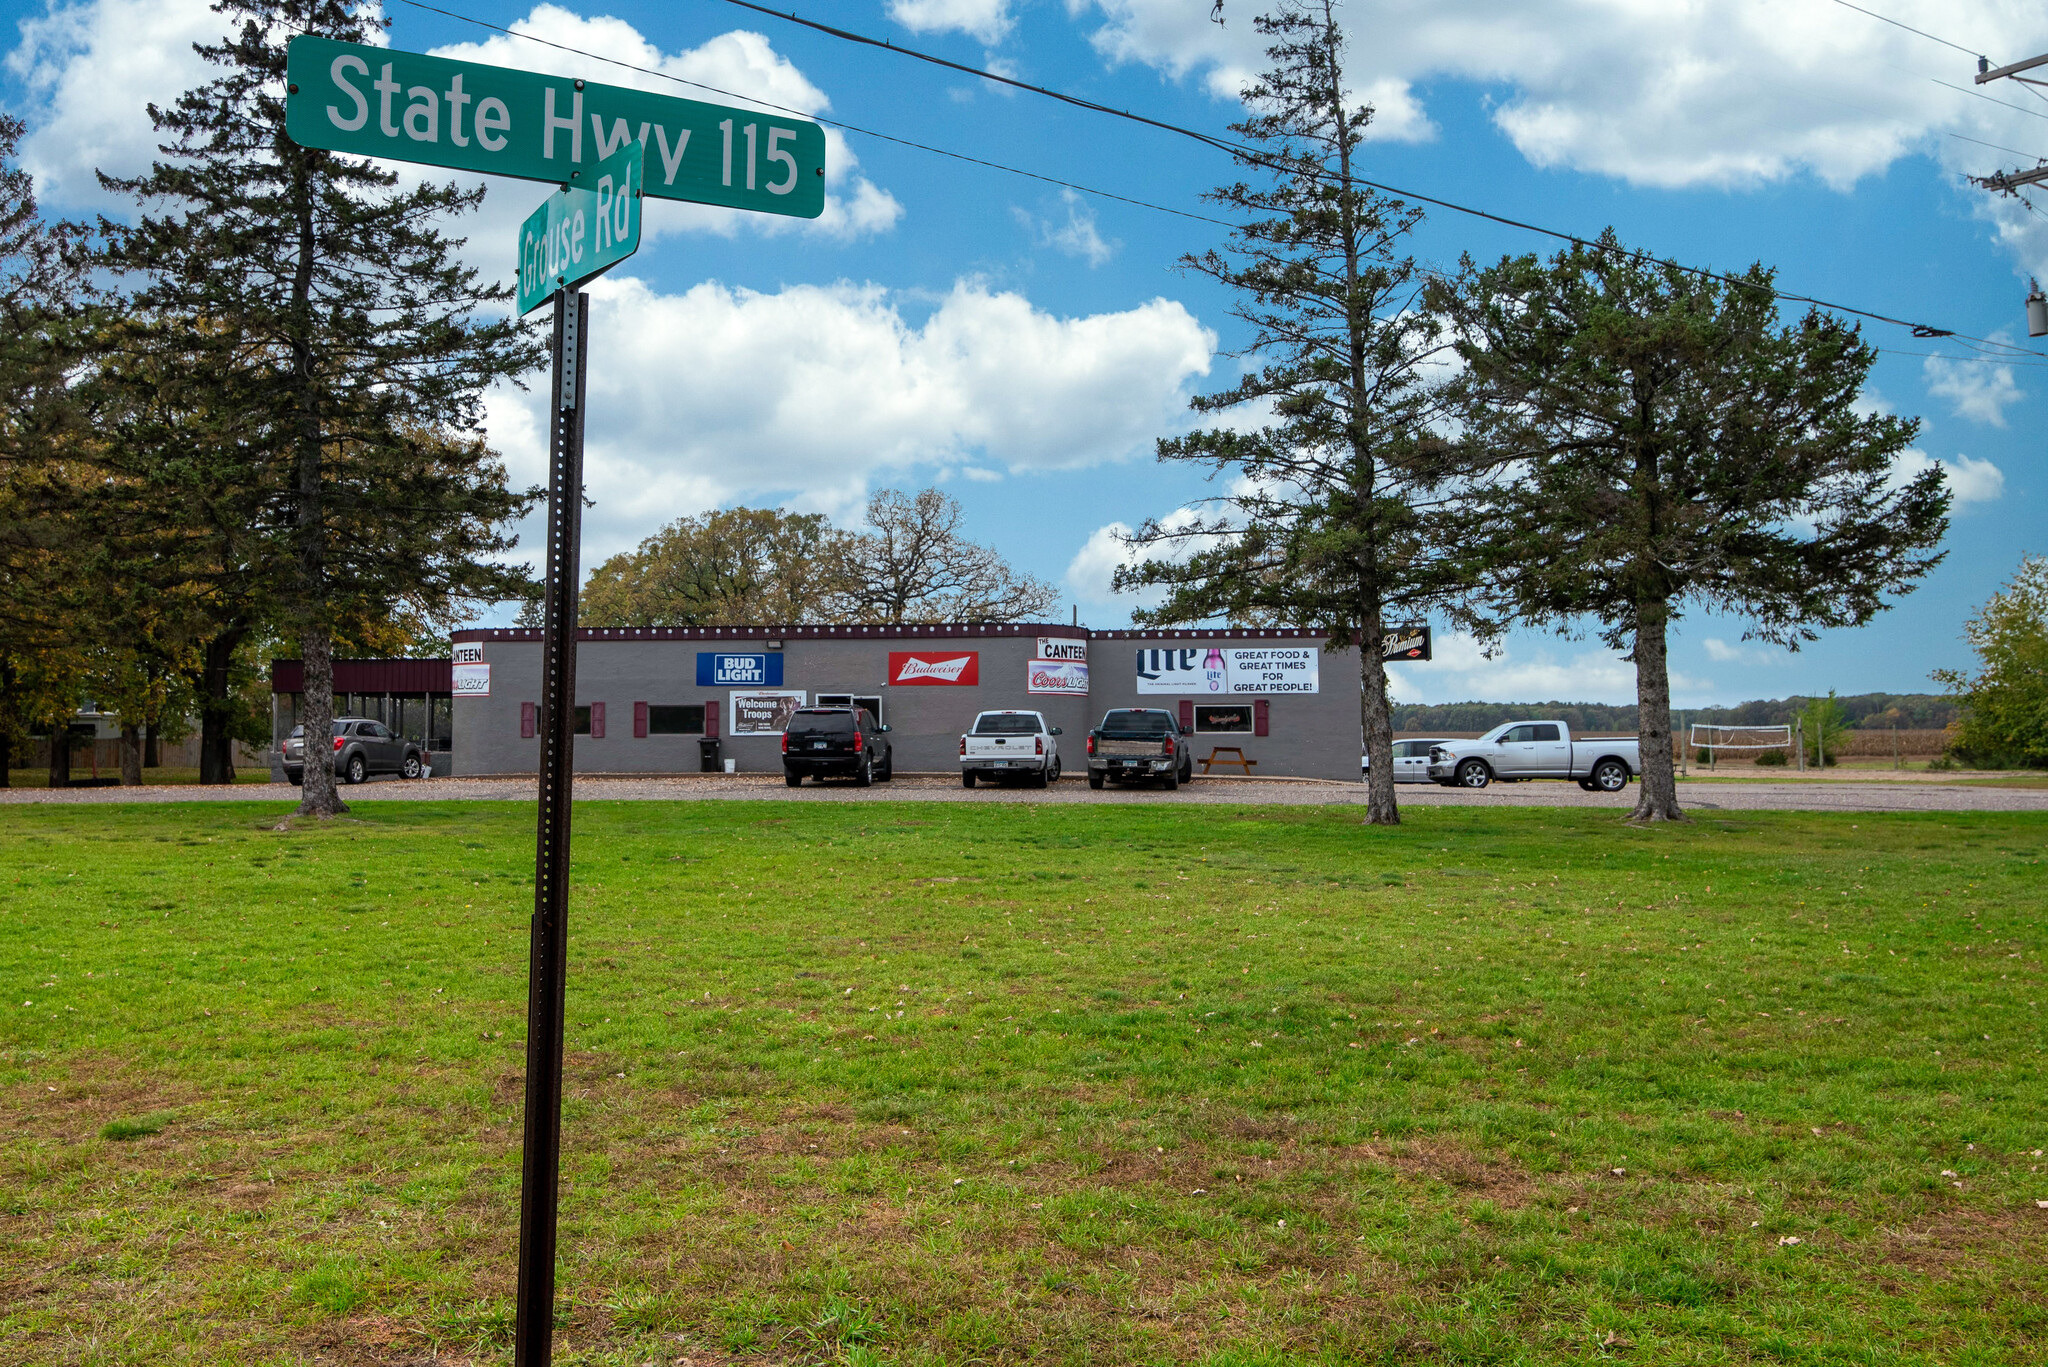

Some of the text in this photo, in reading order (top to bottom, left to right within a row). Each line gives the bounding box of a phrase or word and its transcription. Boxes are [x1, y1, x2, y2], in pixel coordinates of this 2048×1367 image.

[325, 54, 799, 195] State Hwy 115
[523, 160, 632, 298] Grouse Rd
[1038, 637, 1050, 645] THE
[1381, 632, 1425, 658] Premium
[453, 648, 482, 662] ANTEEN
[1044, 644, 1086, 660] CANTEEN
[1234, 650, 1310, 660] GREAT FOOD &
[723, 657, 756, 670] BUD
[902, 662, 963, 675] Budweiser
[1239, 661, 1306, 670] GREAT TIMES
[717, 669, 762, 681] LIGHT
[1032, 671, 1067, 688] Coors
[1206, 670, 1222, 681] Lite
[1262, 672, 1284, 681] FOR
[1233, 683, 1313, 692] GREAT PEOPLE!
[738, 698, 778, 709] Welcome
[742, 708, 773, 720] Troops
